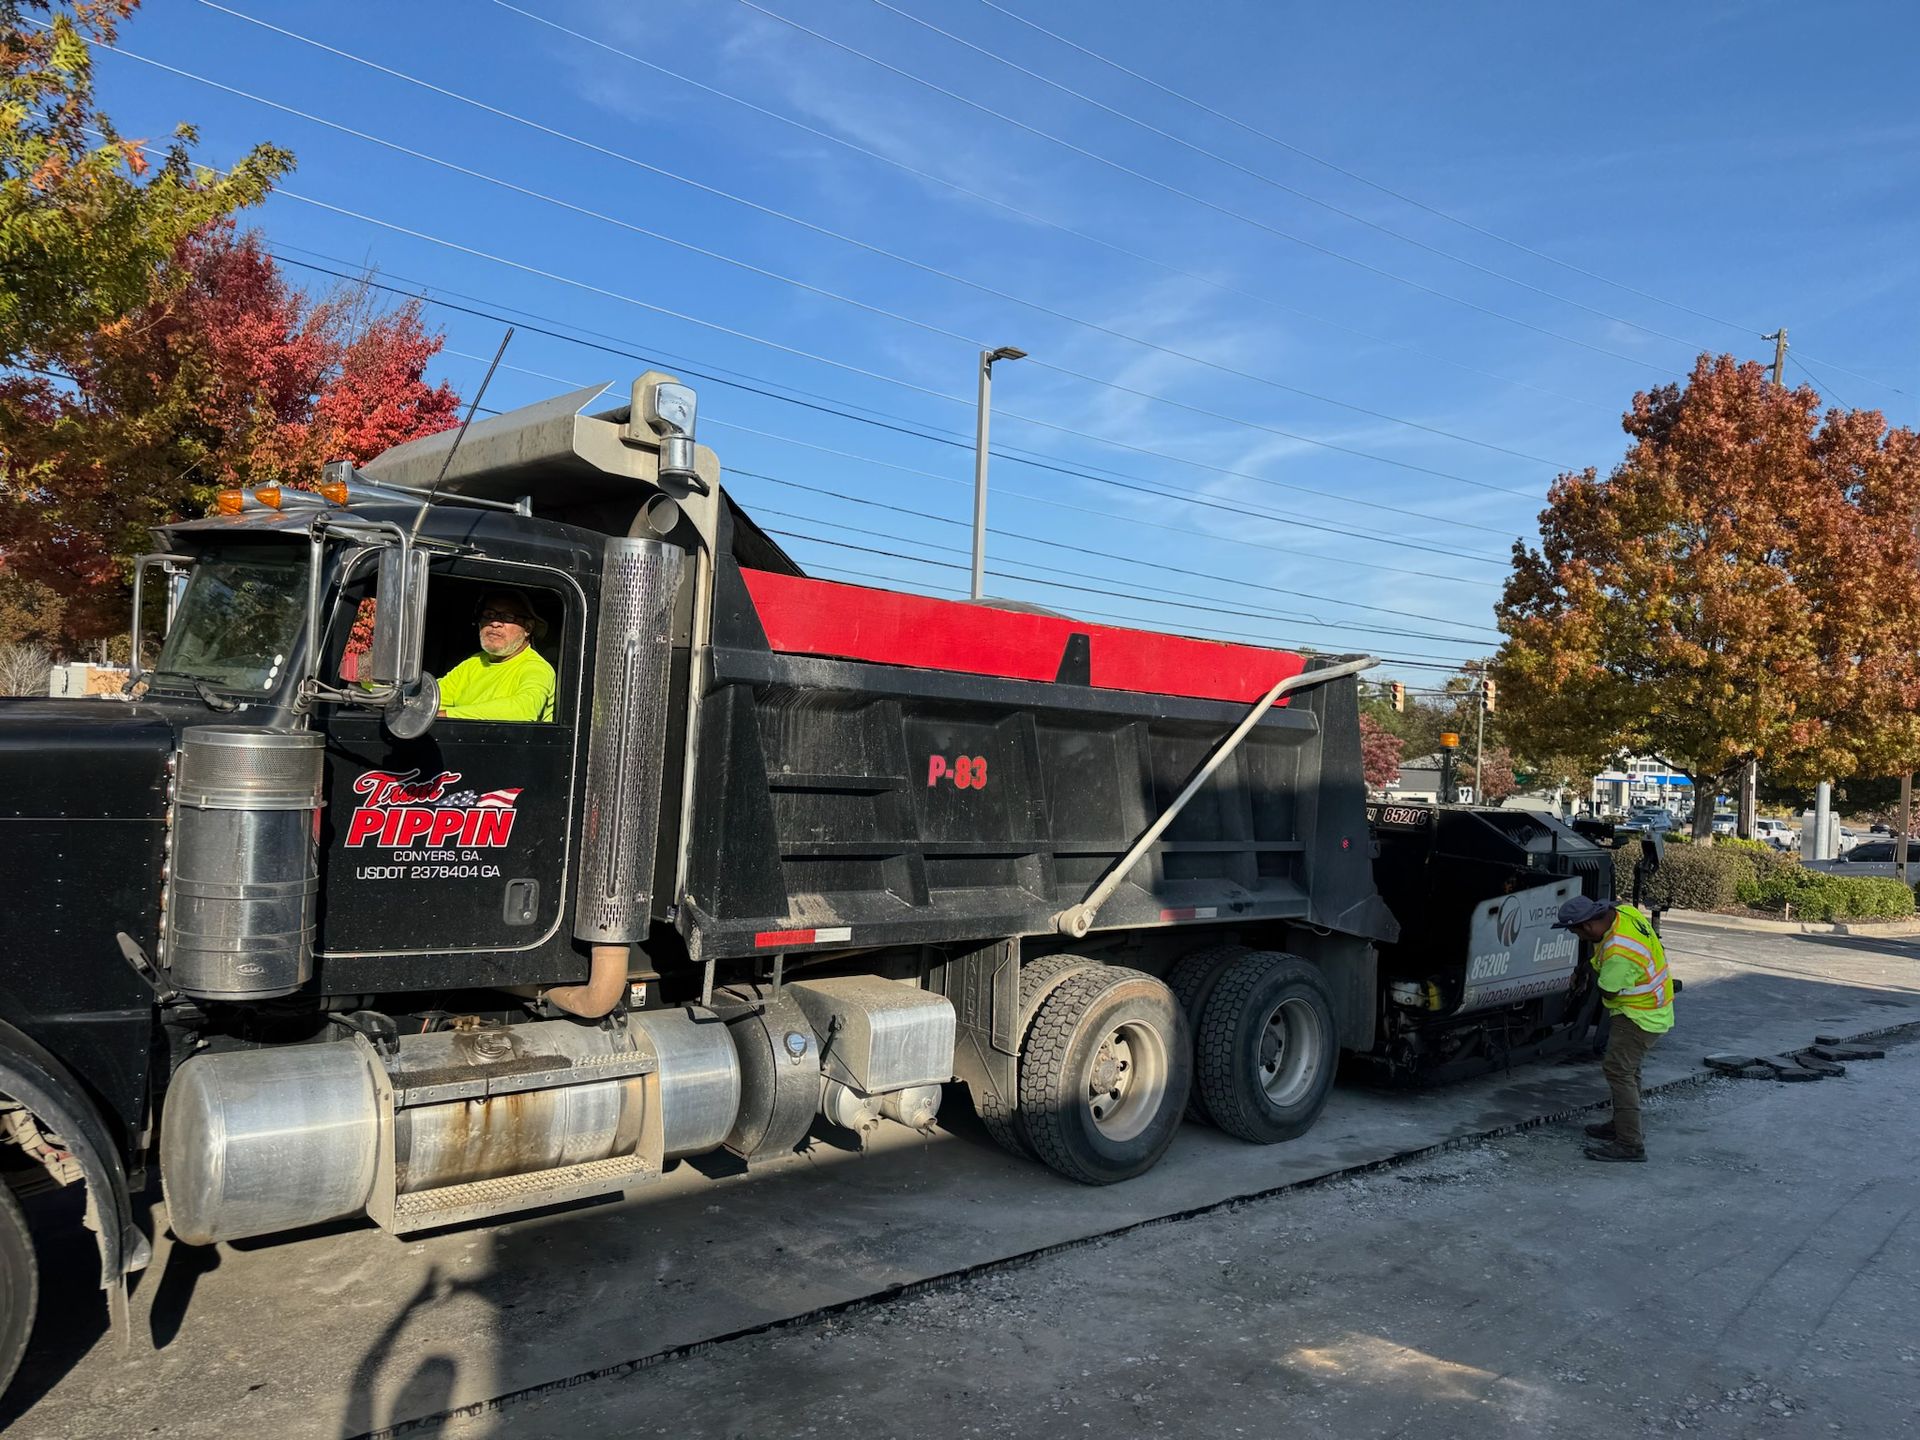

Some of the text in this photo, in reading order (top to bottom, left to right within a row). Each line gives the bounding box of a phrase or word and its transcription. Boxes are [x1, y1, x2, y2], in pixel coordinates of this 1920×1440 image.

[928, 754, 988, 789] P-83
[344, 807, 517, 848] PIPPIN
[1383, 807, 1429, 826] 8520C
[393, 850, 483, 863] CONYERS, GA.
[356, 865, 501, 880] USDOT 2378404 GA
[1529, 907, 1544, 921] VIP
[1533, 933, 1577, 964] LeeBoy
[1471, 951, 1510, 980] 8520C
[1476, 975, 1571, 1006] vippavingco.com
